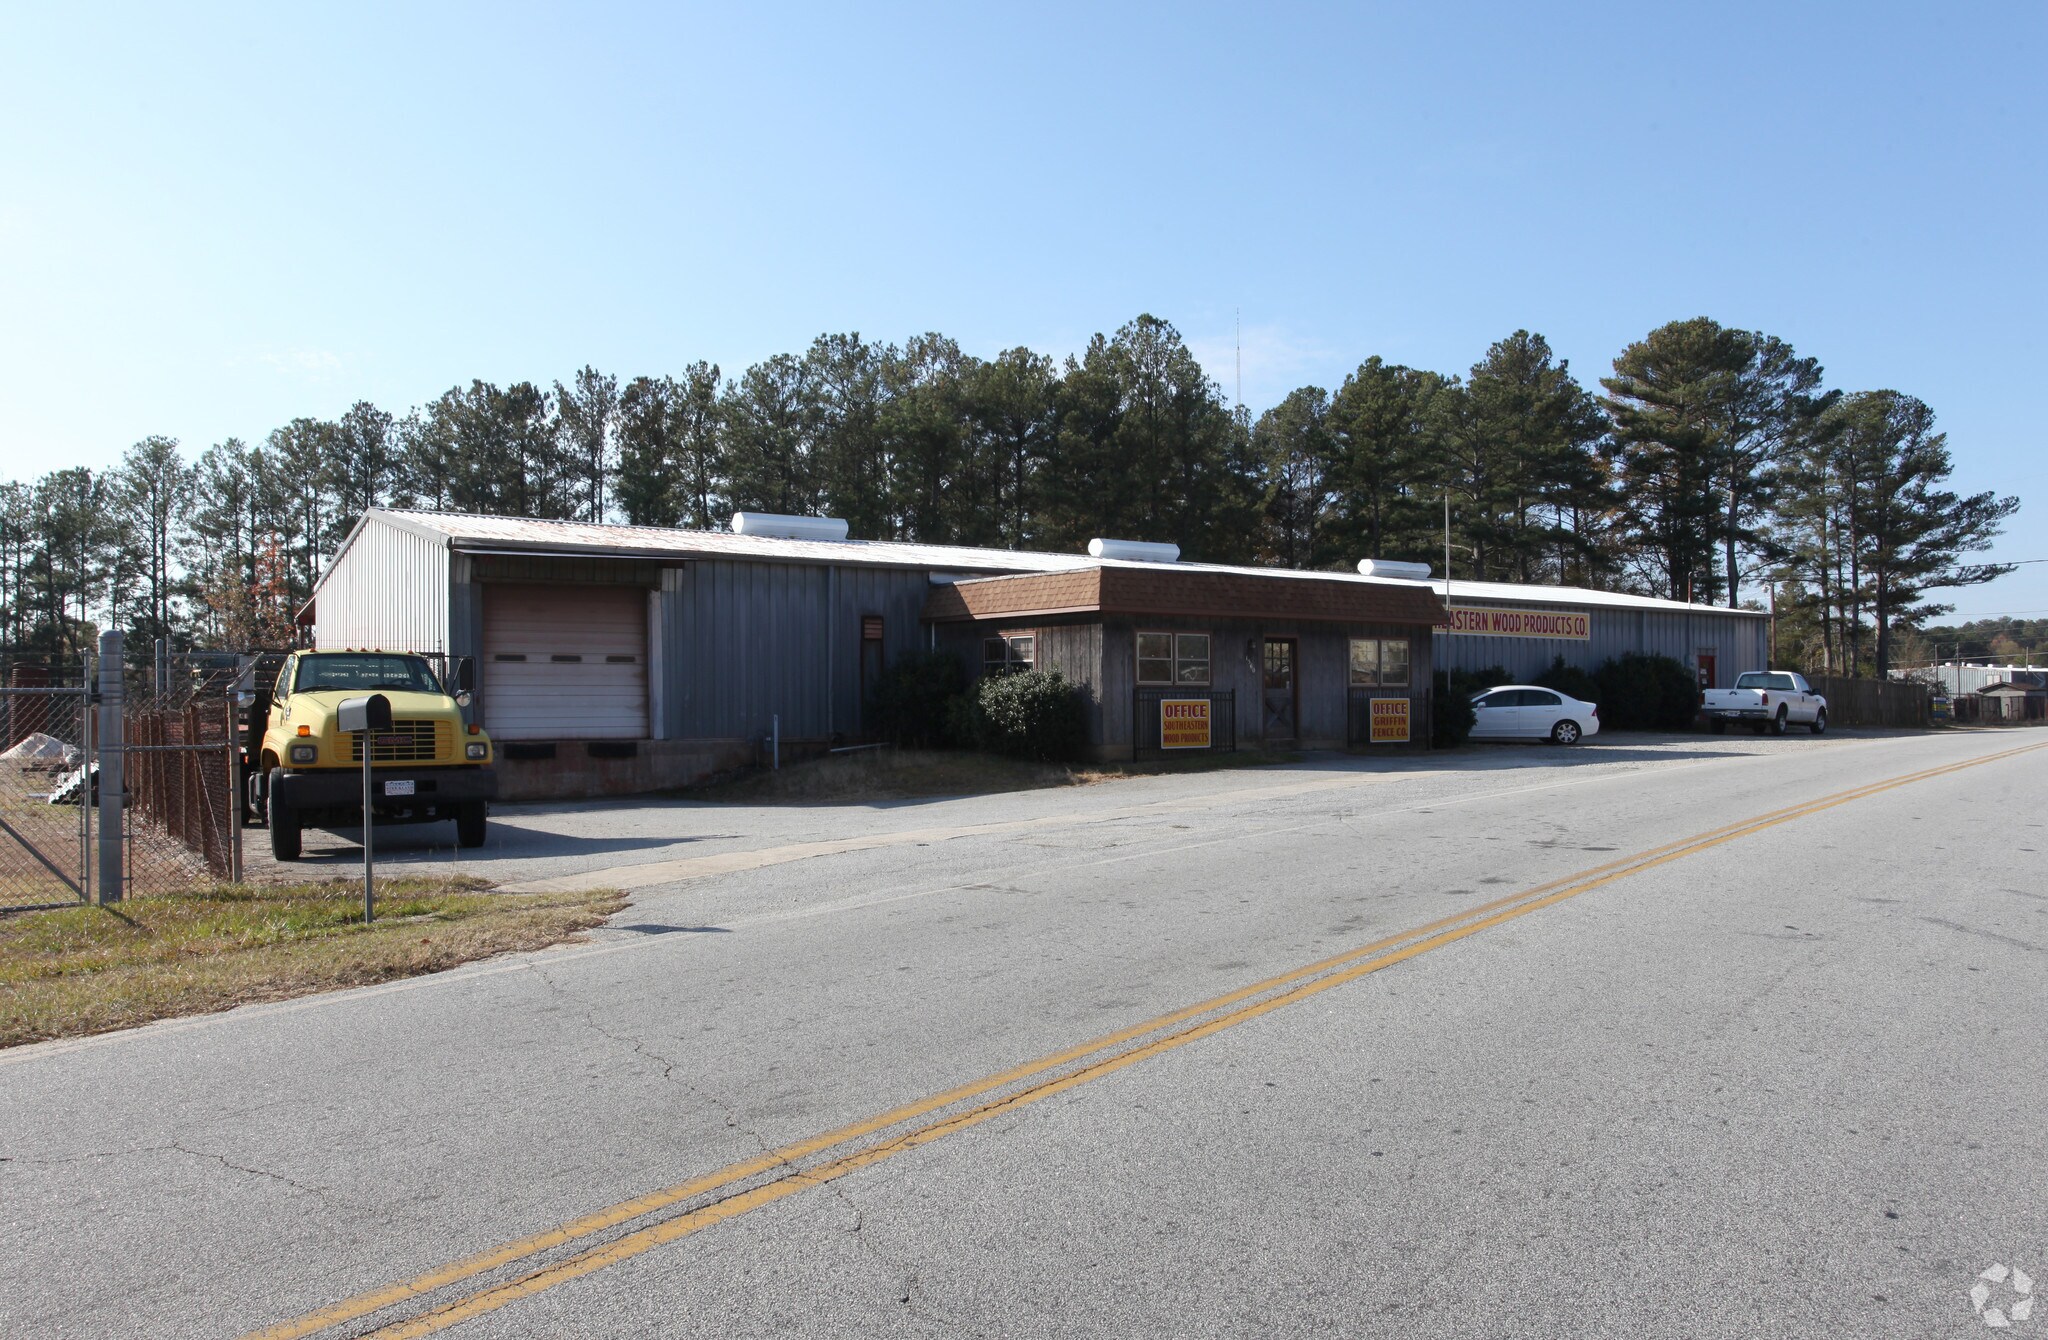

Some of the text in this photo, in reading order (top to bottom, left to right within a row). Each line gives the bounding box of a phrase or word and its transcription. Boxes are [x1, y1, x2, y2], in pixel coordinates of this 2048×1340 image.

[1492, 612, 1521, 633] WOOD
[1524, 614, 1572, 634] PRODUCTS
[1574, 617, 1588, 636] CO.
[1165, 704, 1207, 718] OFFICE
[1373, 703, 1407, 715] OFFICE
[1164, 720, 1208, 730] SOUTHEASTERN
[1374, 716, 1406, 726] GRIFFIN
[1373, 727, 1408, 737] FENCE CO.
[1163, 733, 1180, 743] WOOD
